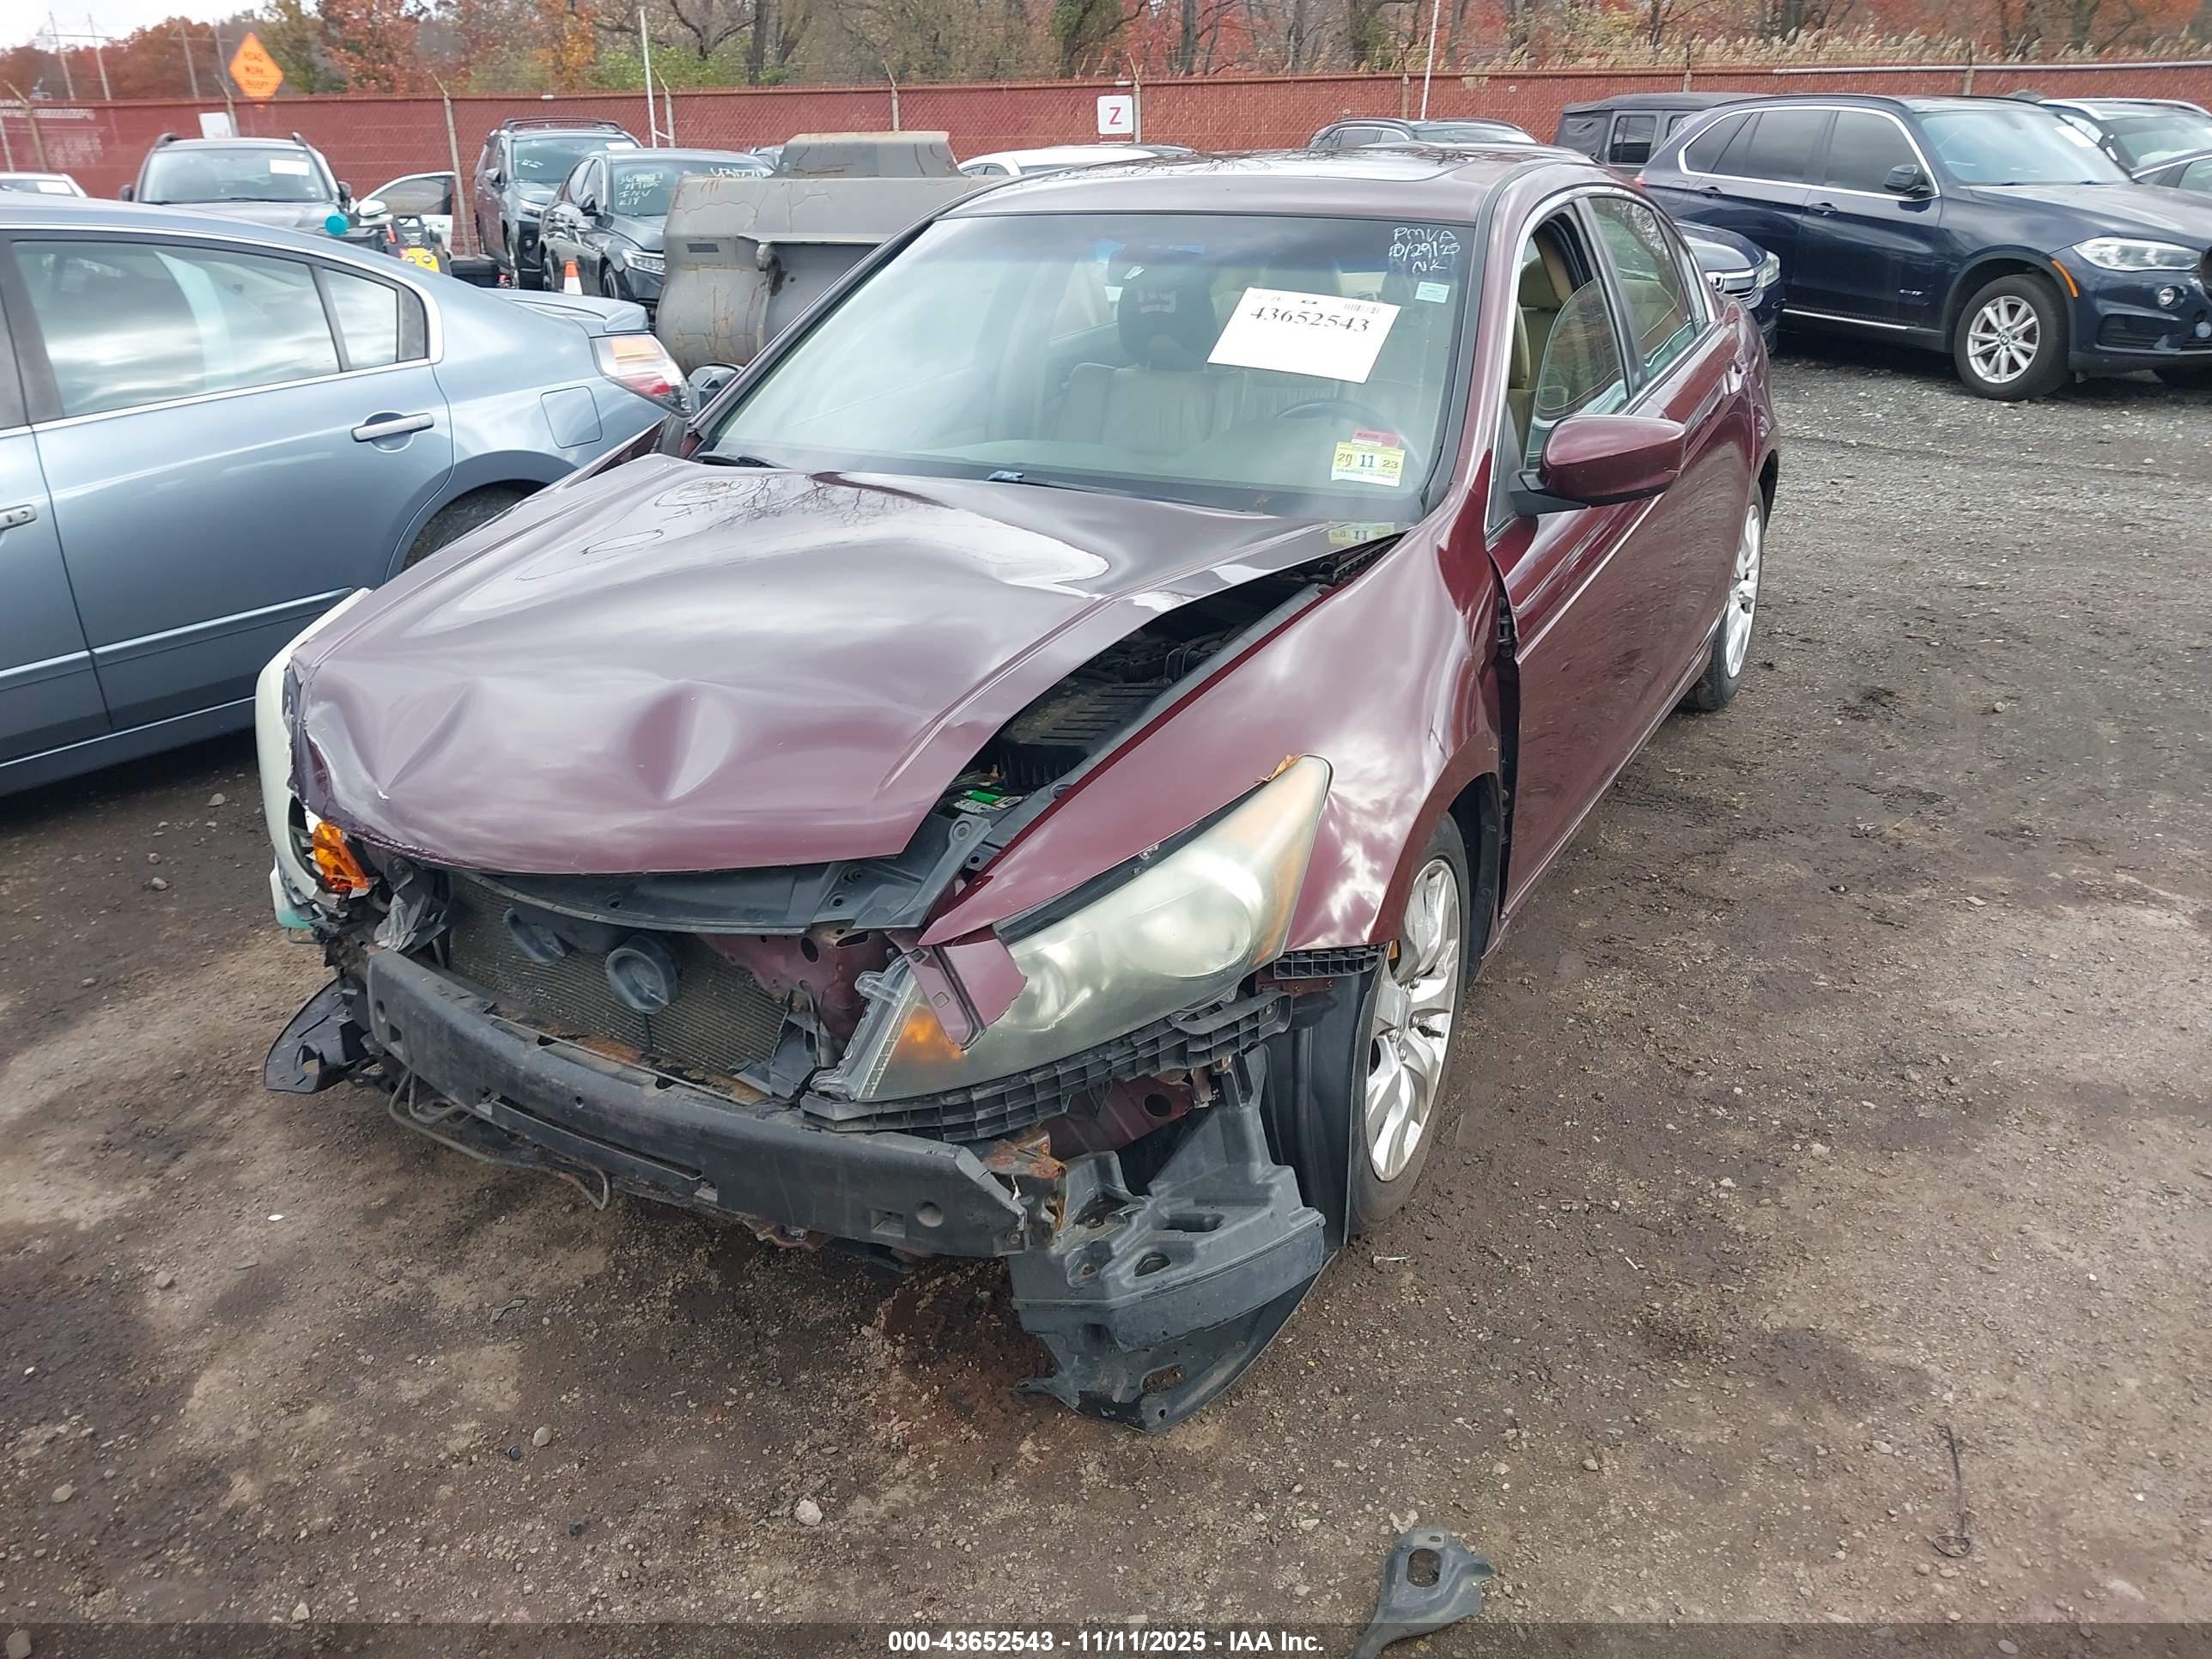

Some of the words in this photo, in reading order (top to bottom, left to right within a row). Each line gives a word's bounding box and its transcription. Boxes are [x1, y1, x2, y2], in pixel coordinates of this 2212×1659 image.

[1109, 106, 1122, 125] Z
[1394, 227, 1456, 242] PMVA
[1250, 307, 1370, 331] 43652543
[1358, 453, 1375, 468] 11
[1382, 459, 1400, 470] 23
